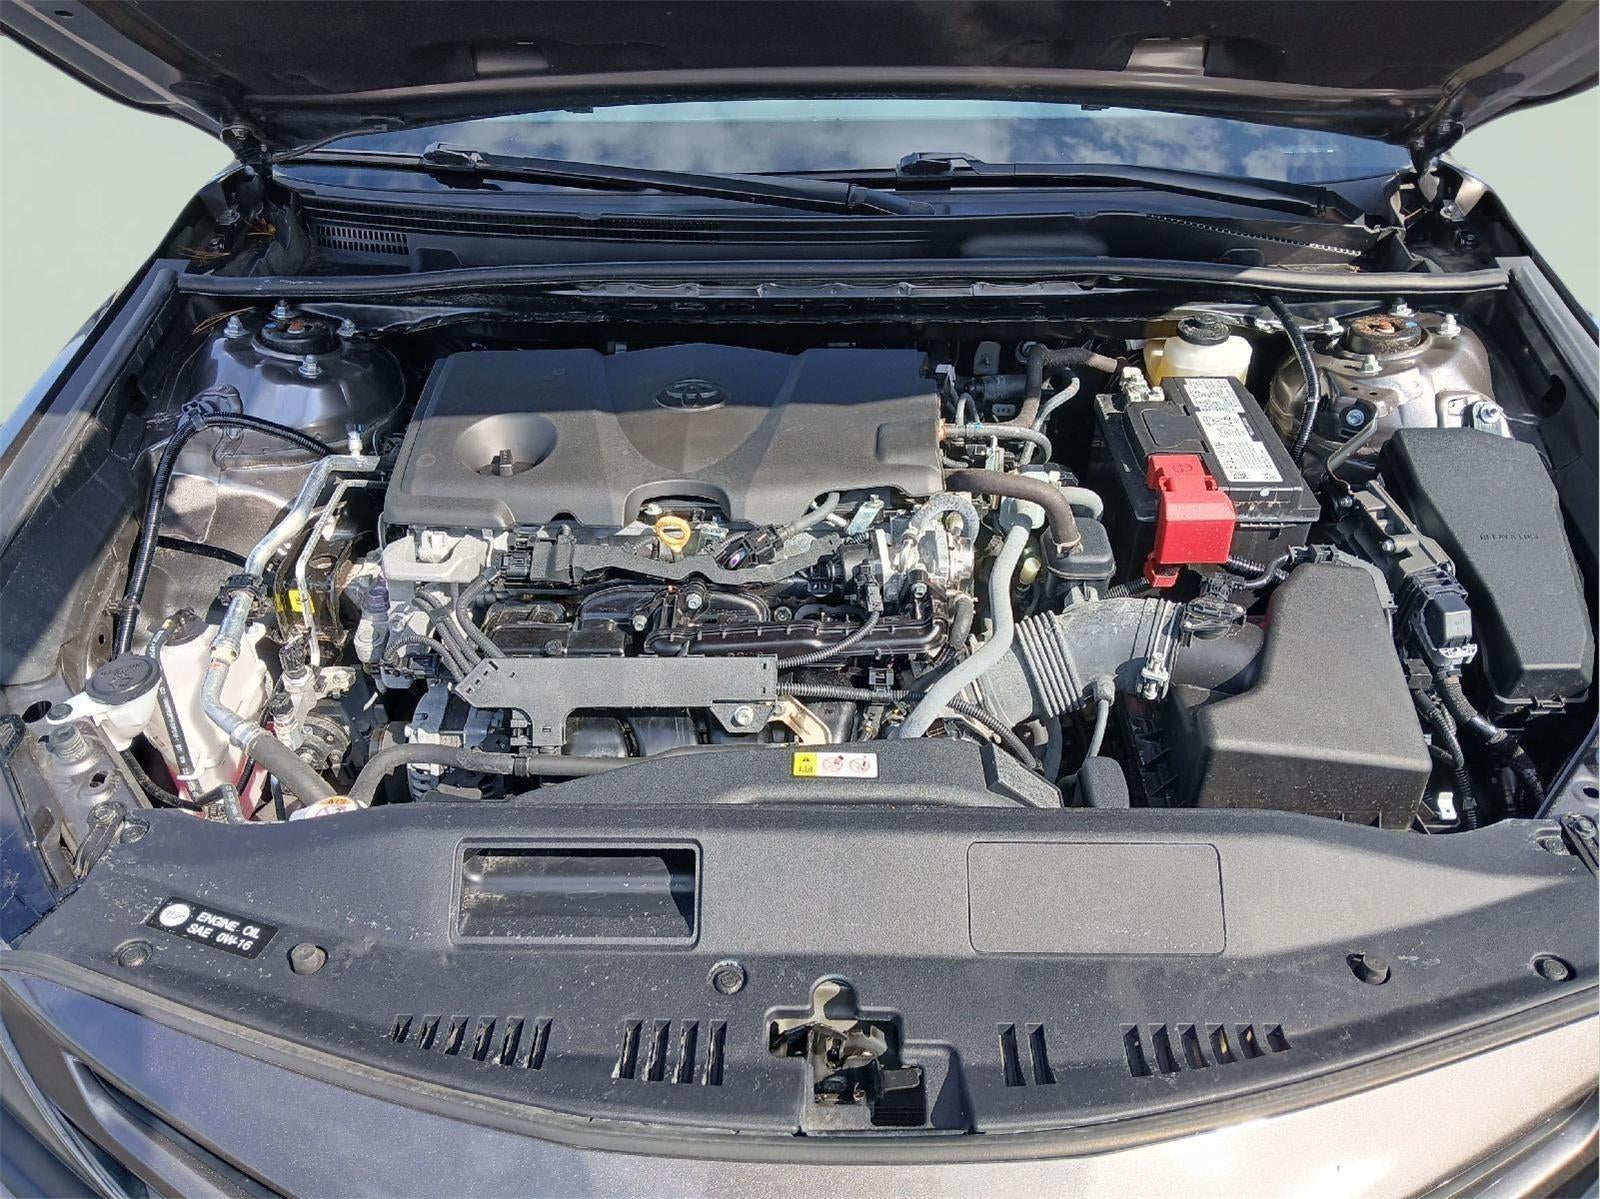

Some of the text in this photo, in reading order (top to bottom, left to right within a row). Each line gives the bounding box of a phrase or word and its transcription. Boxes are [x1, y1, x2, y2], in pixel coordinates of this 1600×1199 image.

[186, 923, 253, 951] SAE 0W-16
[196, 911, 261, 939] ENGINE OIL
